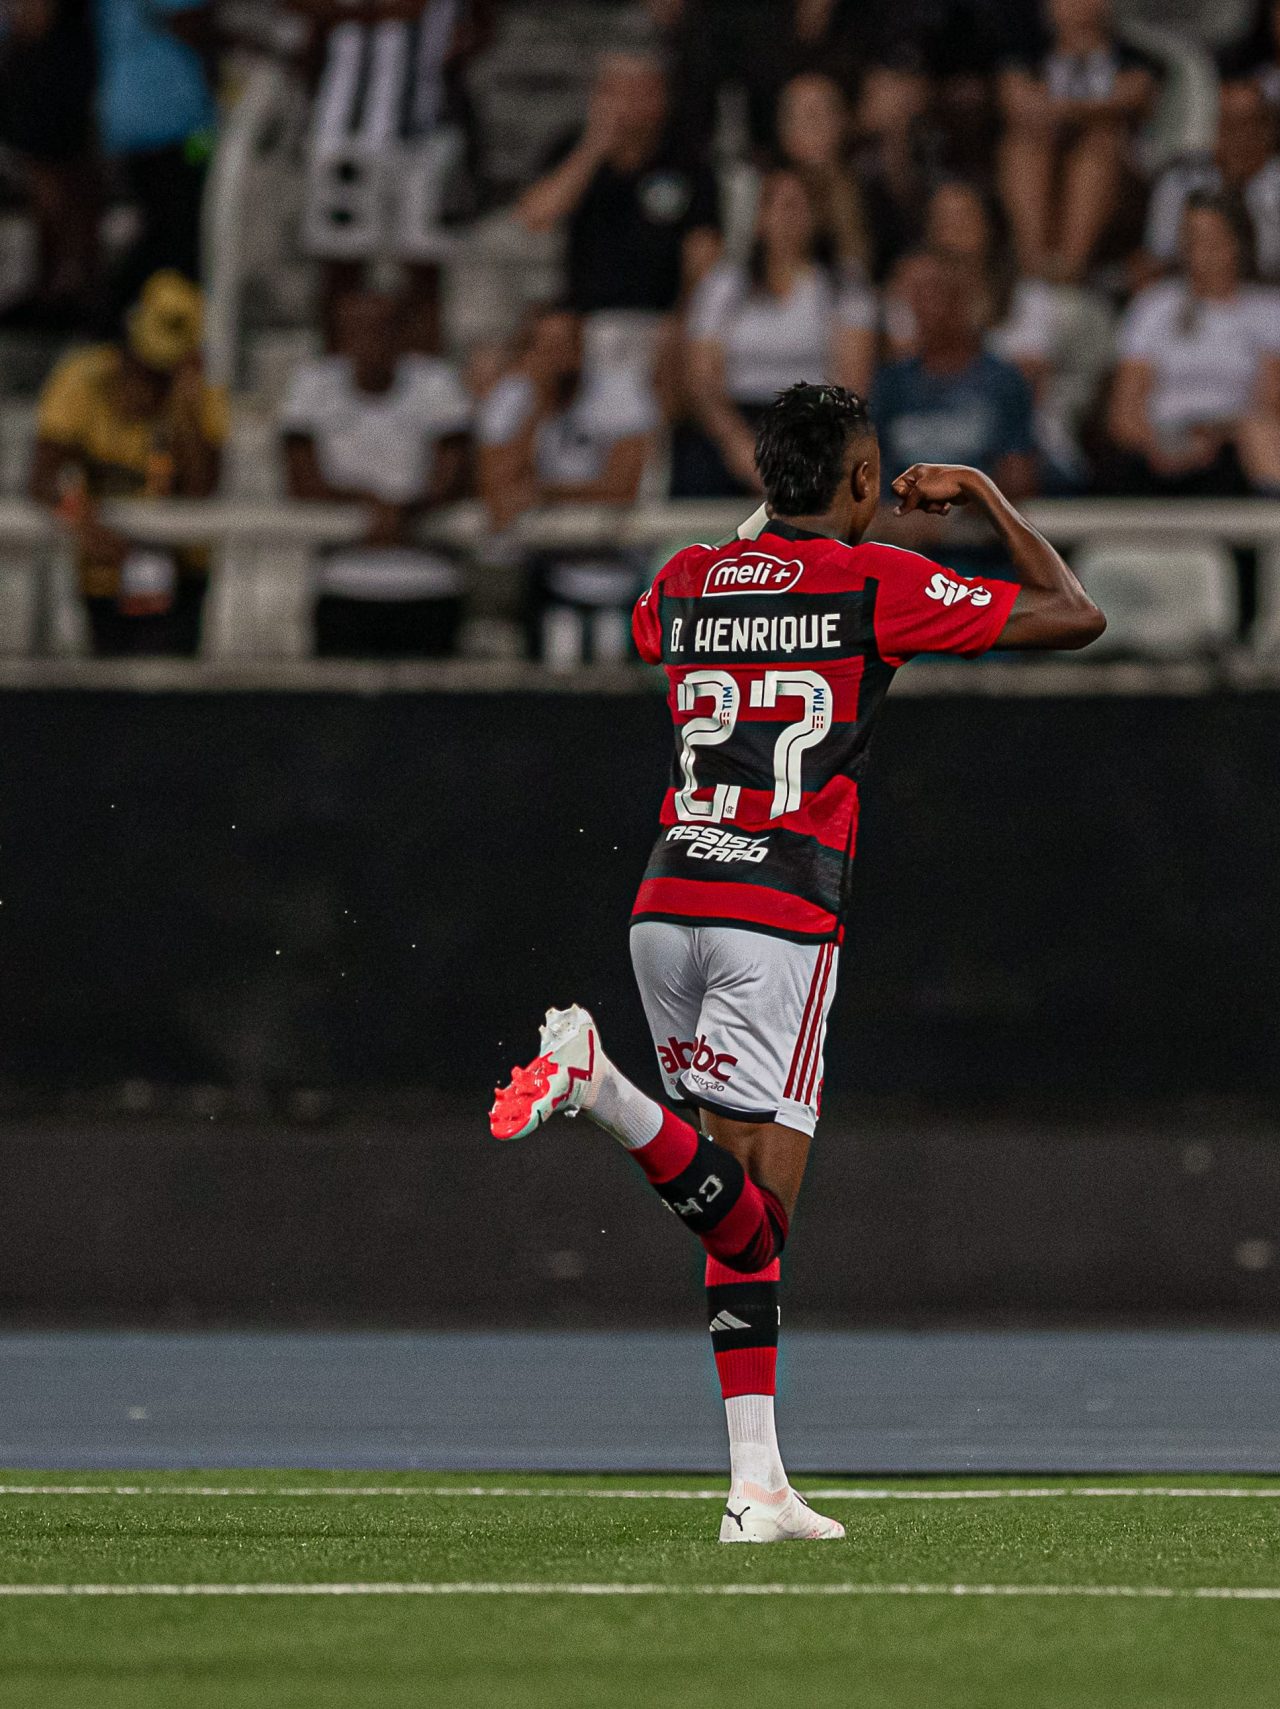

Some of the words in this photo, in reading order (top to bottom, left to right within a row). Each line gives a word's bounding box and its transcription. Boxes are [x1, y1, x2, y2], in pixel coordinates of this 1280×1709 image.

[714, 561, 791, 587] meli+
[694, 613, 841, 653] HENRIQUE
[722, 686, 733, 710] TIM
[812, 688, 825, 713] TIM
[674, 670, 833, 824] 27
[666, 825, 770, 850] ASSIST
